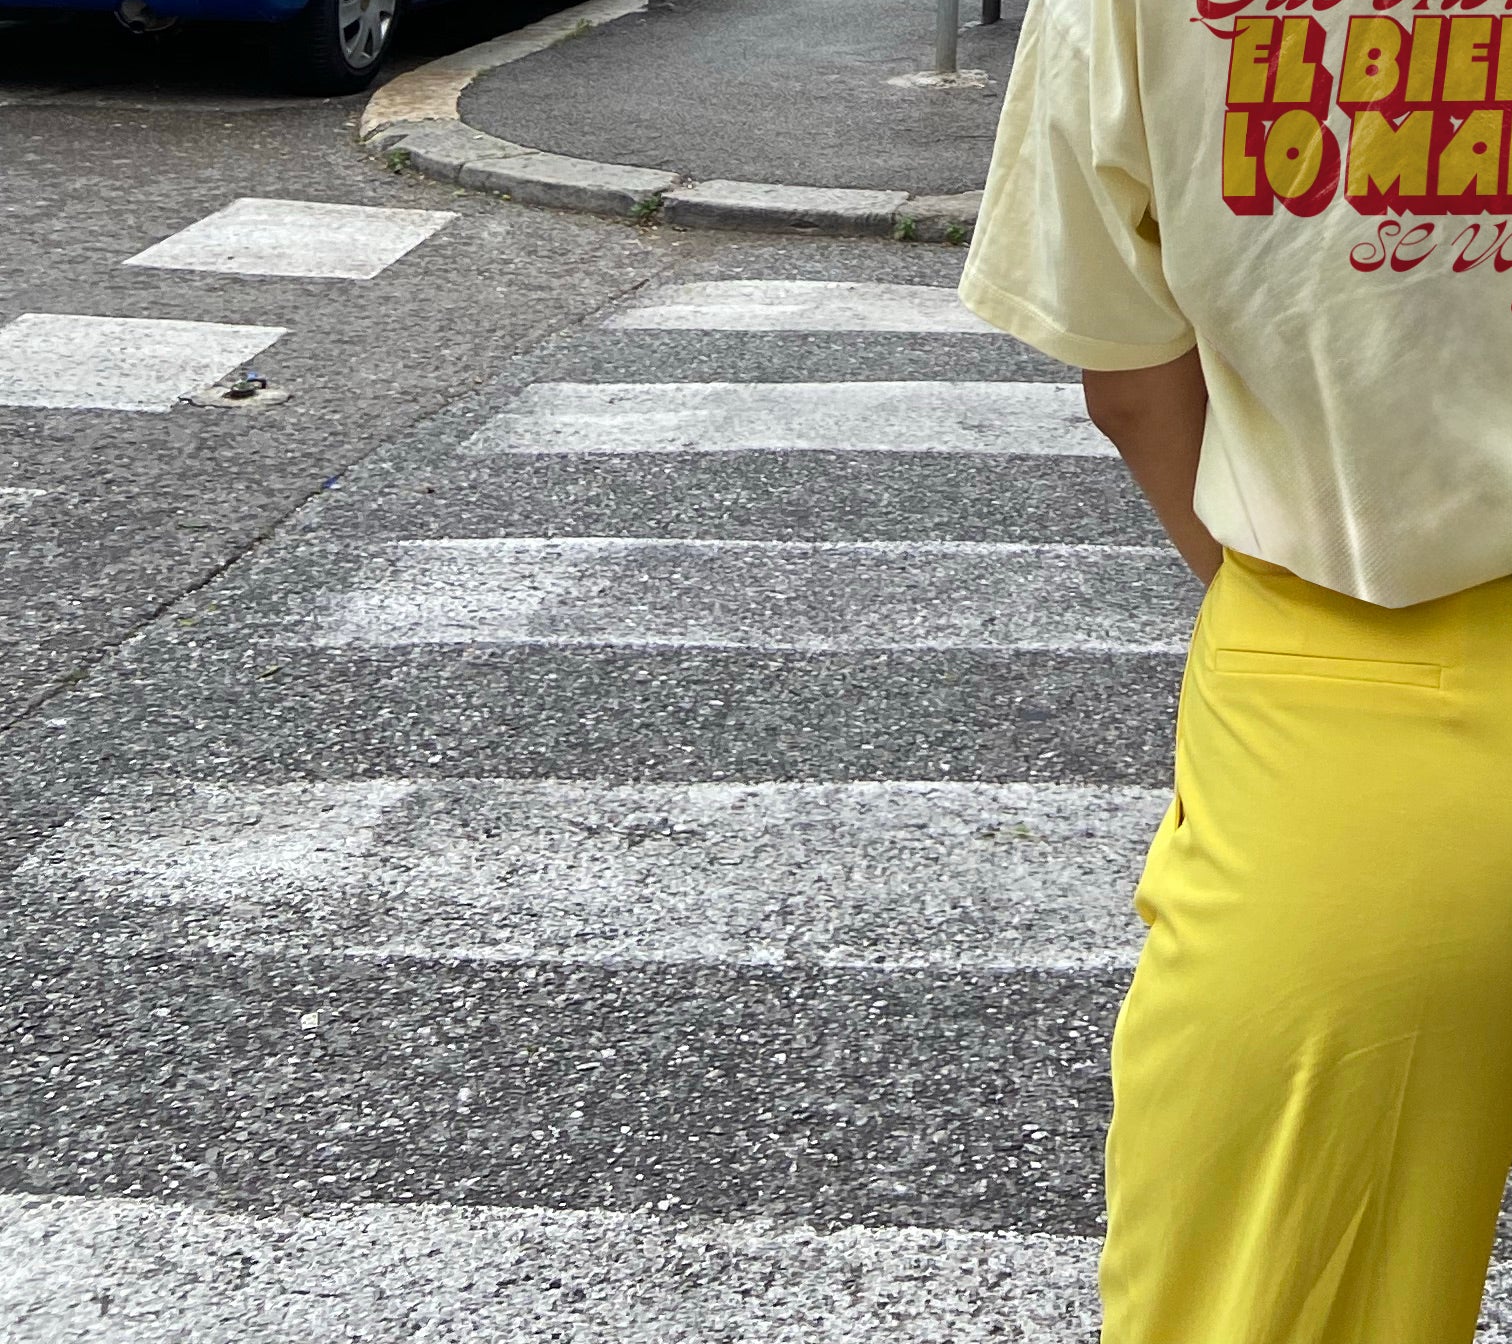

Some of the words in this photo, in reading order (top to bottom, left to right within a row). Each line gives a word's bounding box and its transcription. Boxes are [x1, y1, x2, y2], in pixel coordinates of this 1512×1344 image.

[1224, 14, 1334, 118] EL
[1221, 108, 1342, 218] LO
[1349, 218, 1438, 273] se
